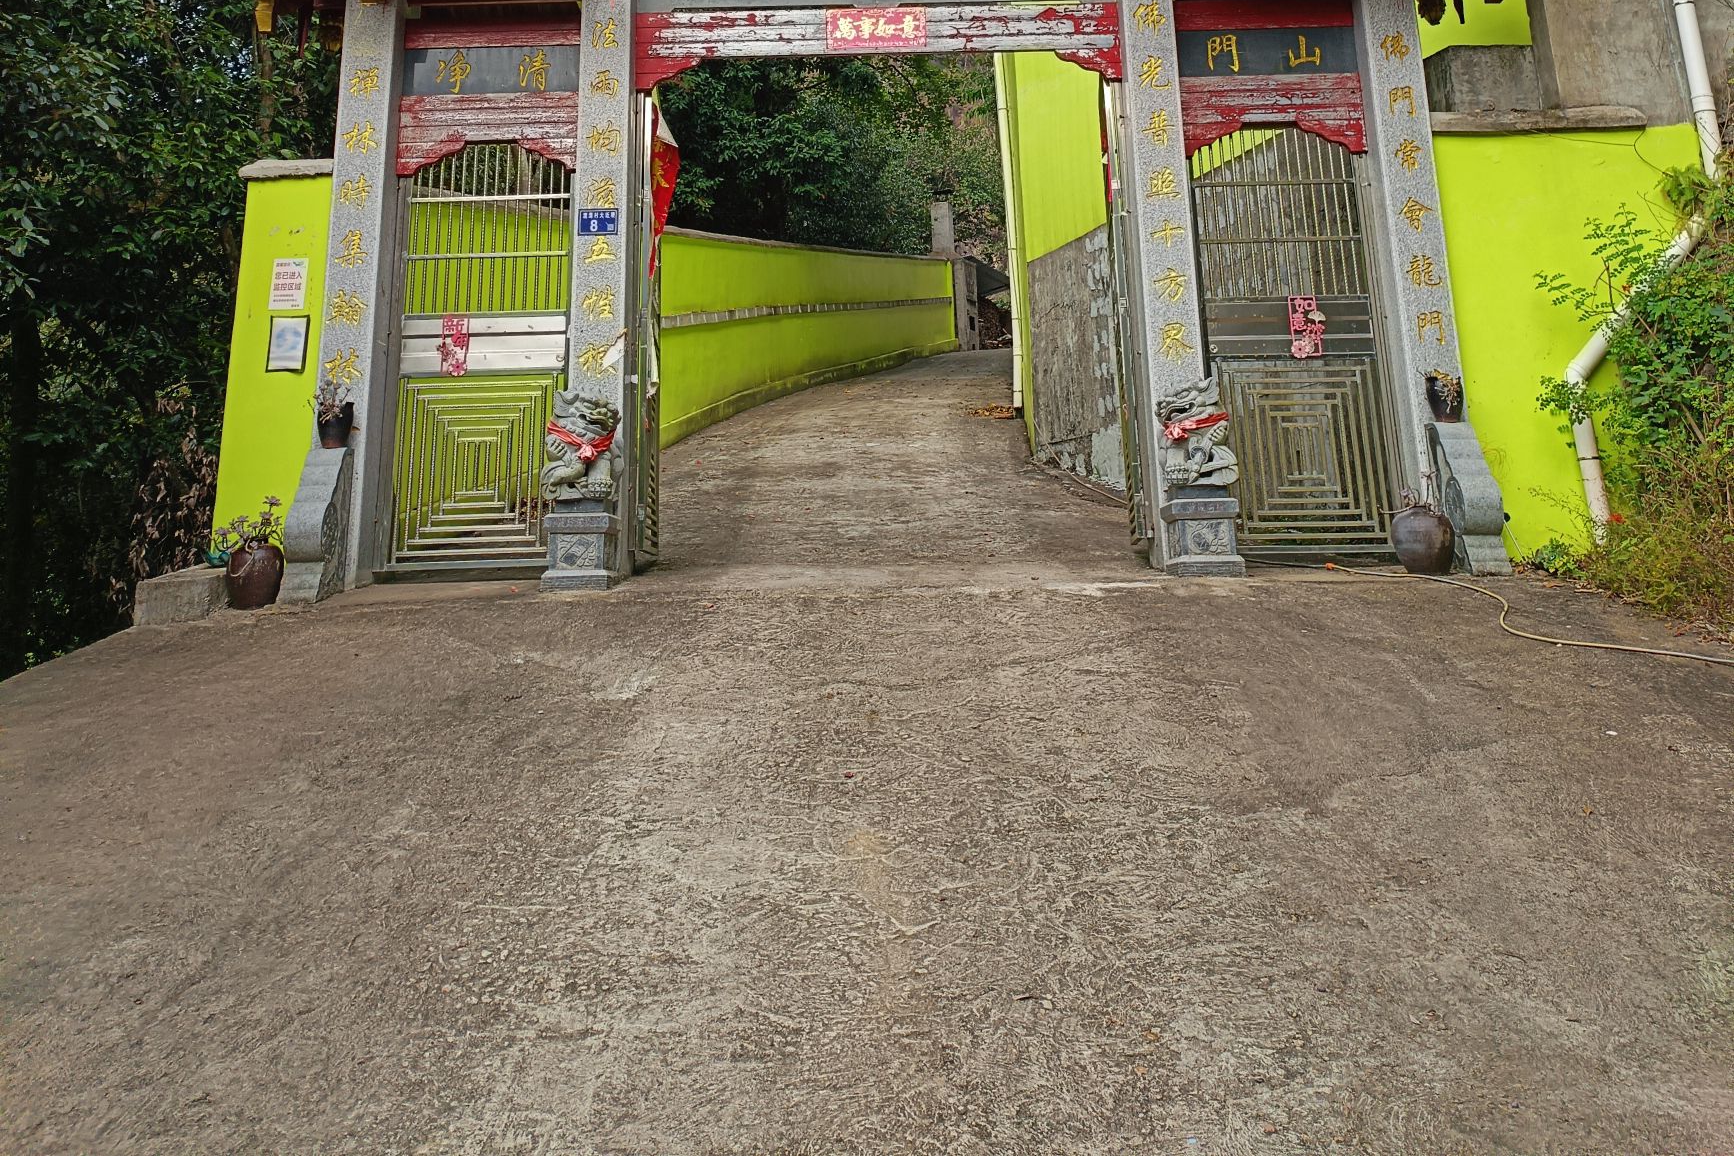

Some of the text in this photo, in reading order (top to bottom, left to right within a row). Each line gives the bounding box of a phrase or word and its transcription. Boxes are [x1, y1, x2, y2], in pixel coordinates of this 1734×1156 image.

[833, 15, 920, 40] 萬事如意
[1206, 34, 1321, 73] 山門
[1132, 2, 1194, 364] 佛光普照十方界
[1380, 31, 1453, 381] 佛門常會龍門
[589, 219, 598, 232] 8
[275, 271, 303, 280] 您已进入
